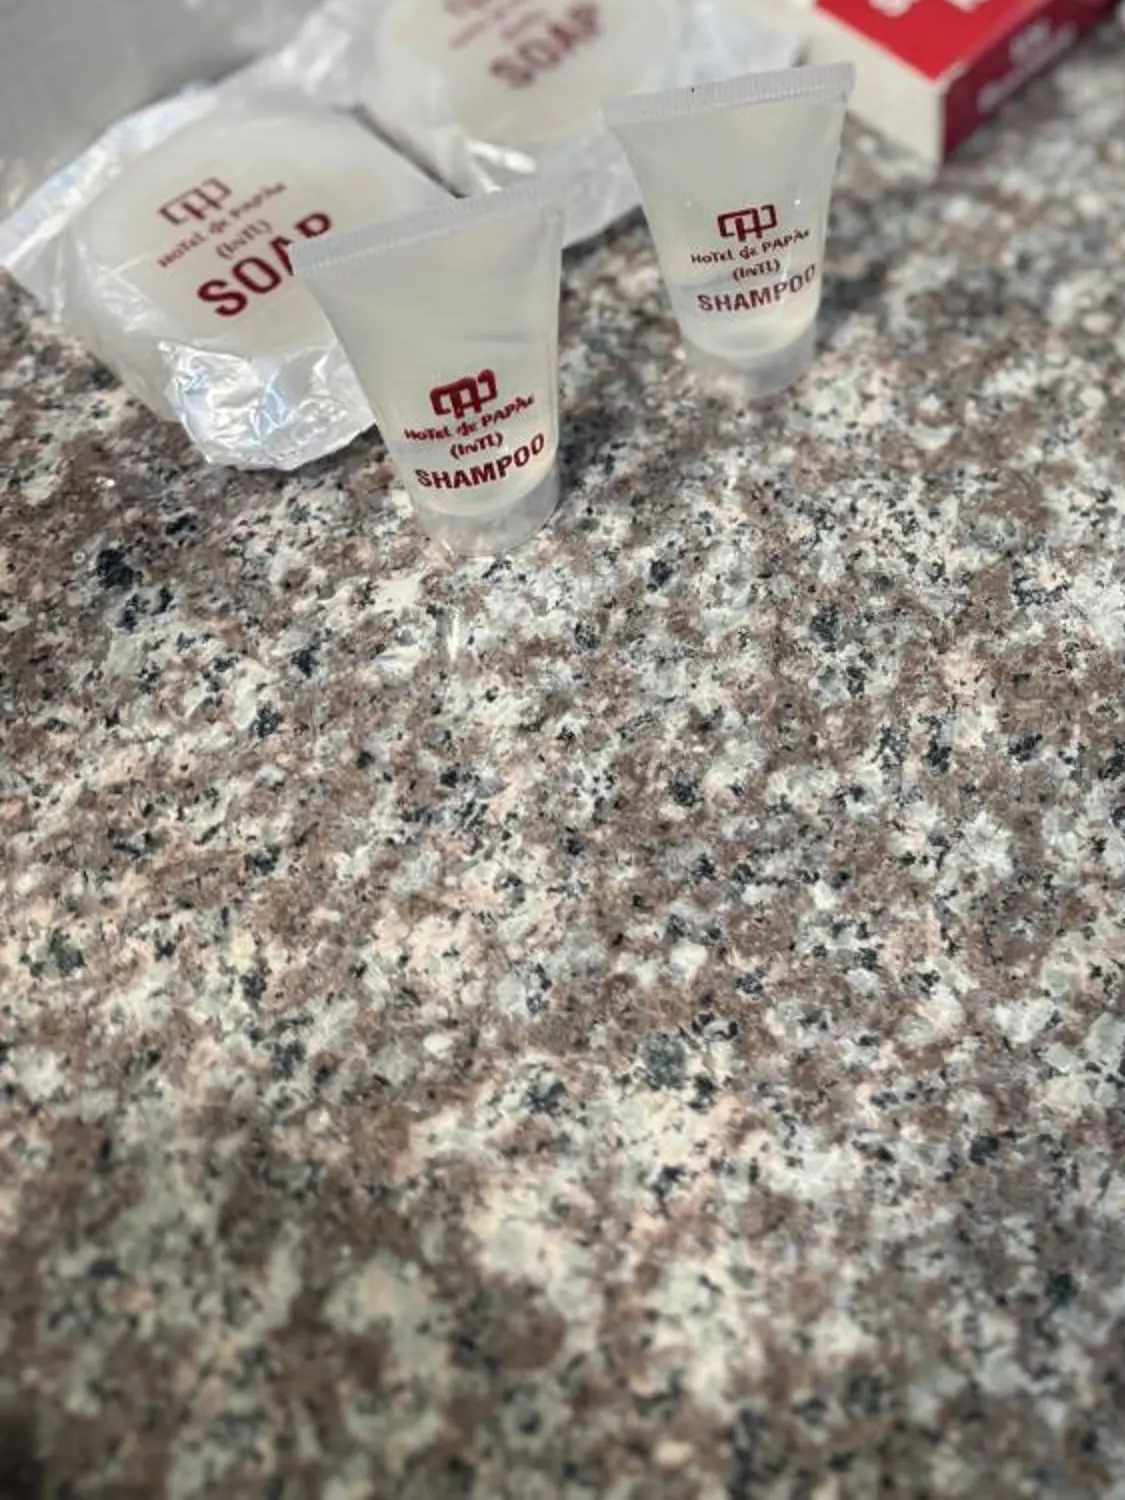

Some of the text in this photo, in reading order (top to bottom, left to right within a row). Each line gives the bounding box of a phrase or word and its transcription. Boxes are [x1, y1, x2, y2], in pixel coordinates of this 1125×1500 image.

[488, 2, 602, 89] SOAP
[697, 264, 815, 312] SHAMPOO
[415, 433, 544, 489] SHAMPOO
